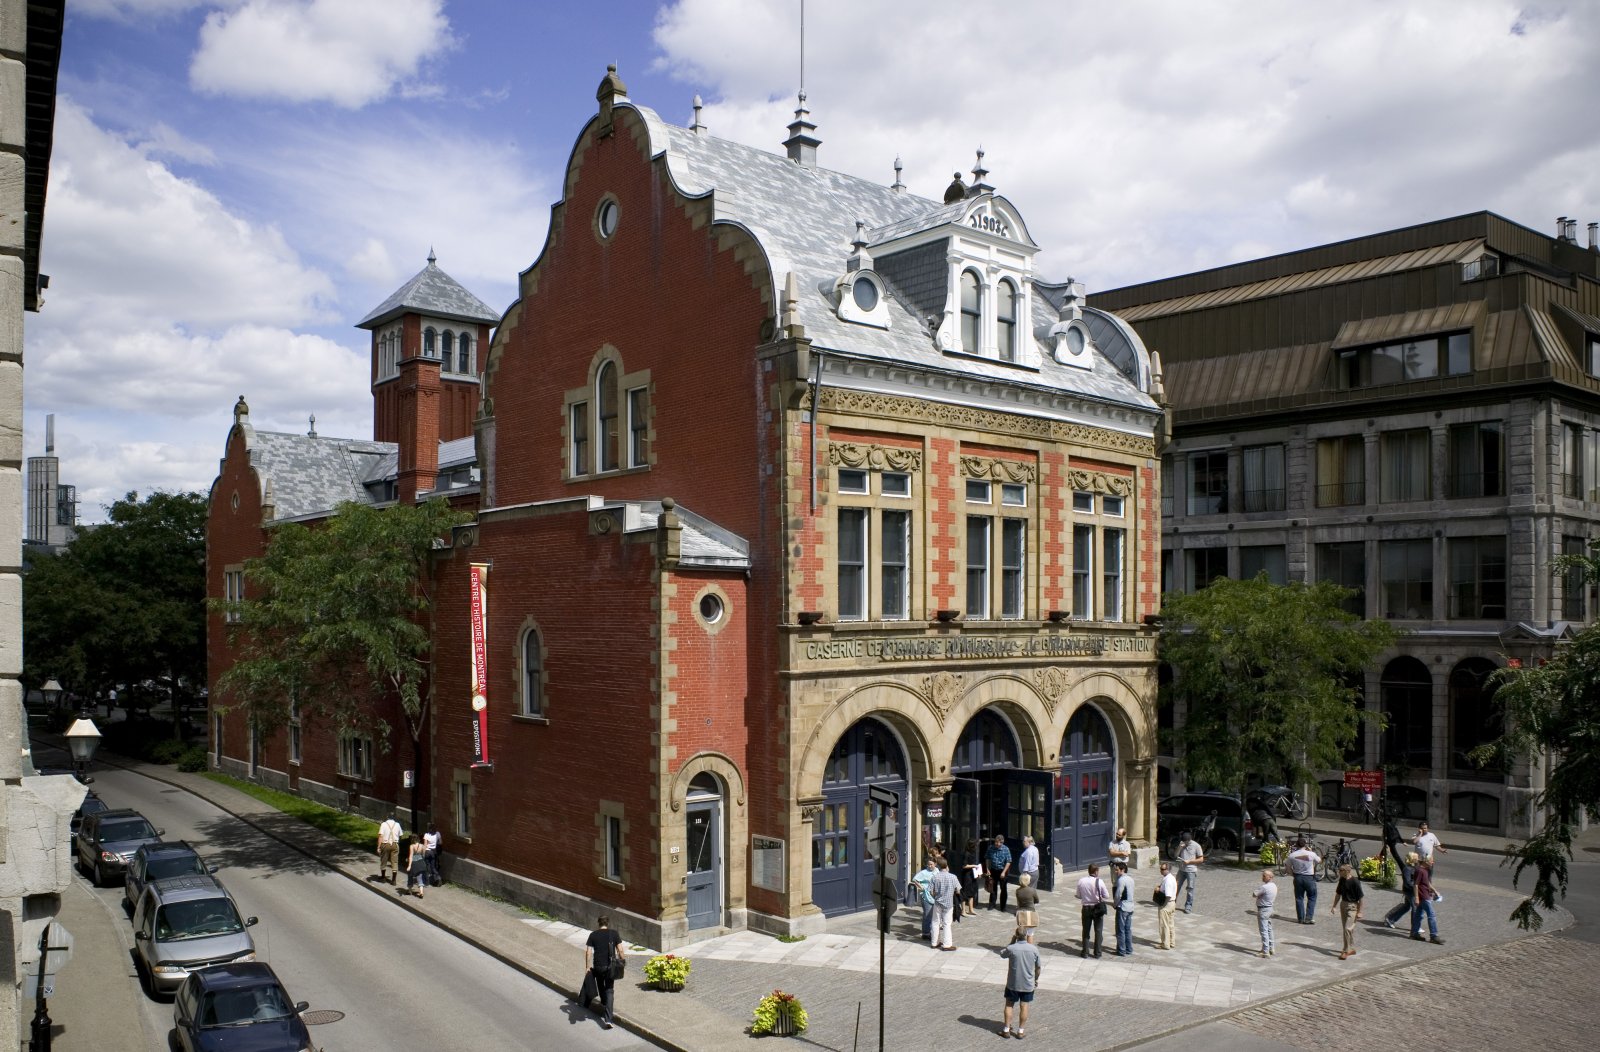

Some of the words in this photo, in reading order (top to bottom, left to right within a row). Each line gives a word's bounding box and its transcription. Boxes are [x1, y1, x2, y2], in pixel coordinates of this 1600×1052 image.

[978, 214, 1002, 233] 1903
[471, 572, 479, 600] CENTRE
[473, 602, 482, 641] D'HISTOIRE
[476, 643, 483, 653] DE
[807, 640, 863, 660] CASERNE
[1113, 637, 1151, 652] STATION
[477, 654, 486, 693] MONTRÉAL
[472, 719, 480, 756] EXPOSITIONS
